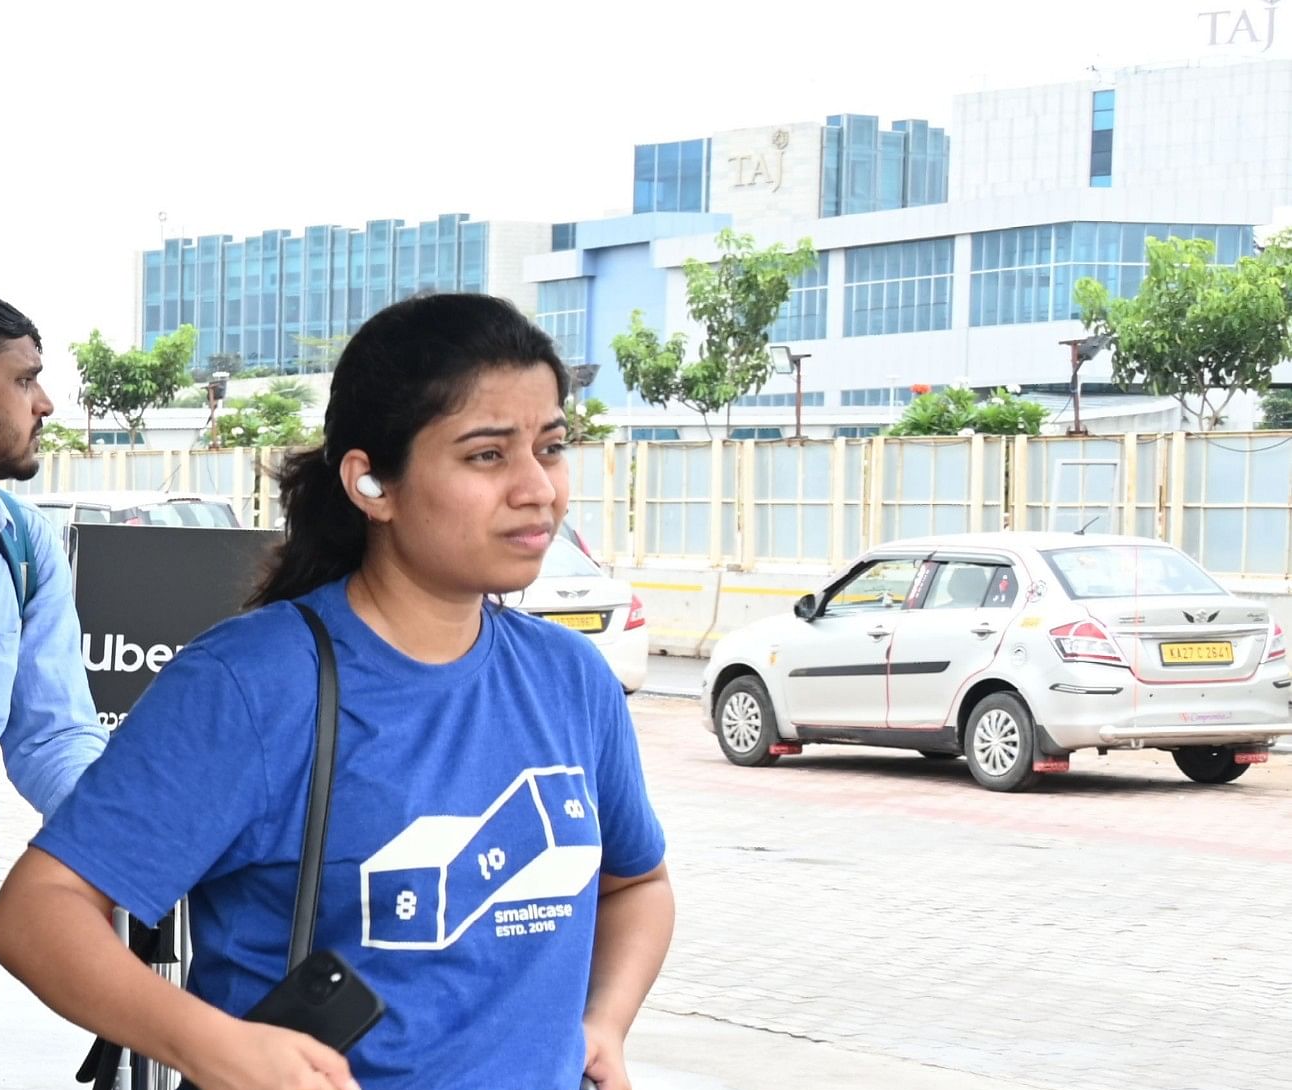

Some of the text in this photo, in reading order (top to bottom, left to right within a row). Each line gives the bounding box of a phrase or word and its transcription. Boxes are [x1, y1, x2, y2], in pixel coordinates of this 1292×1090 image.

[1198, 7, 1278, 53] TAJ
[728, 151, 785, 193] TAJ
[477, 847, 506, 881] 10
[395, 890, 417, 921] 8
[494, 903, 573, 924] smallcase
[495, 919, 556, 938] ESTD. 2016
